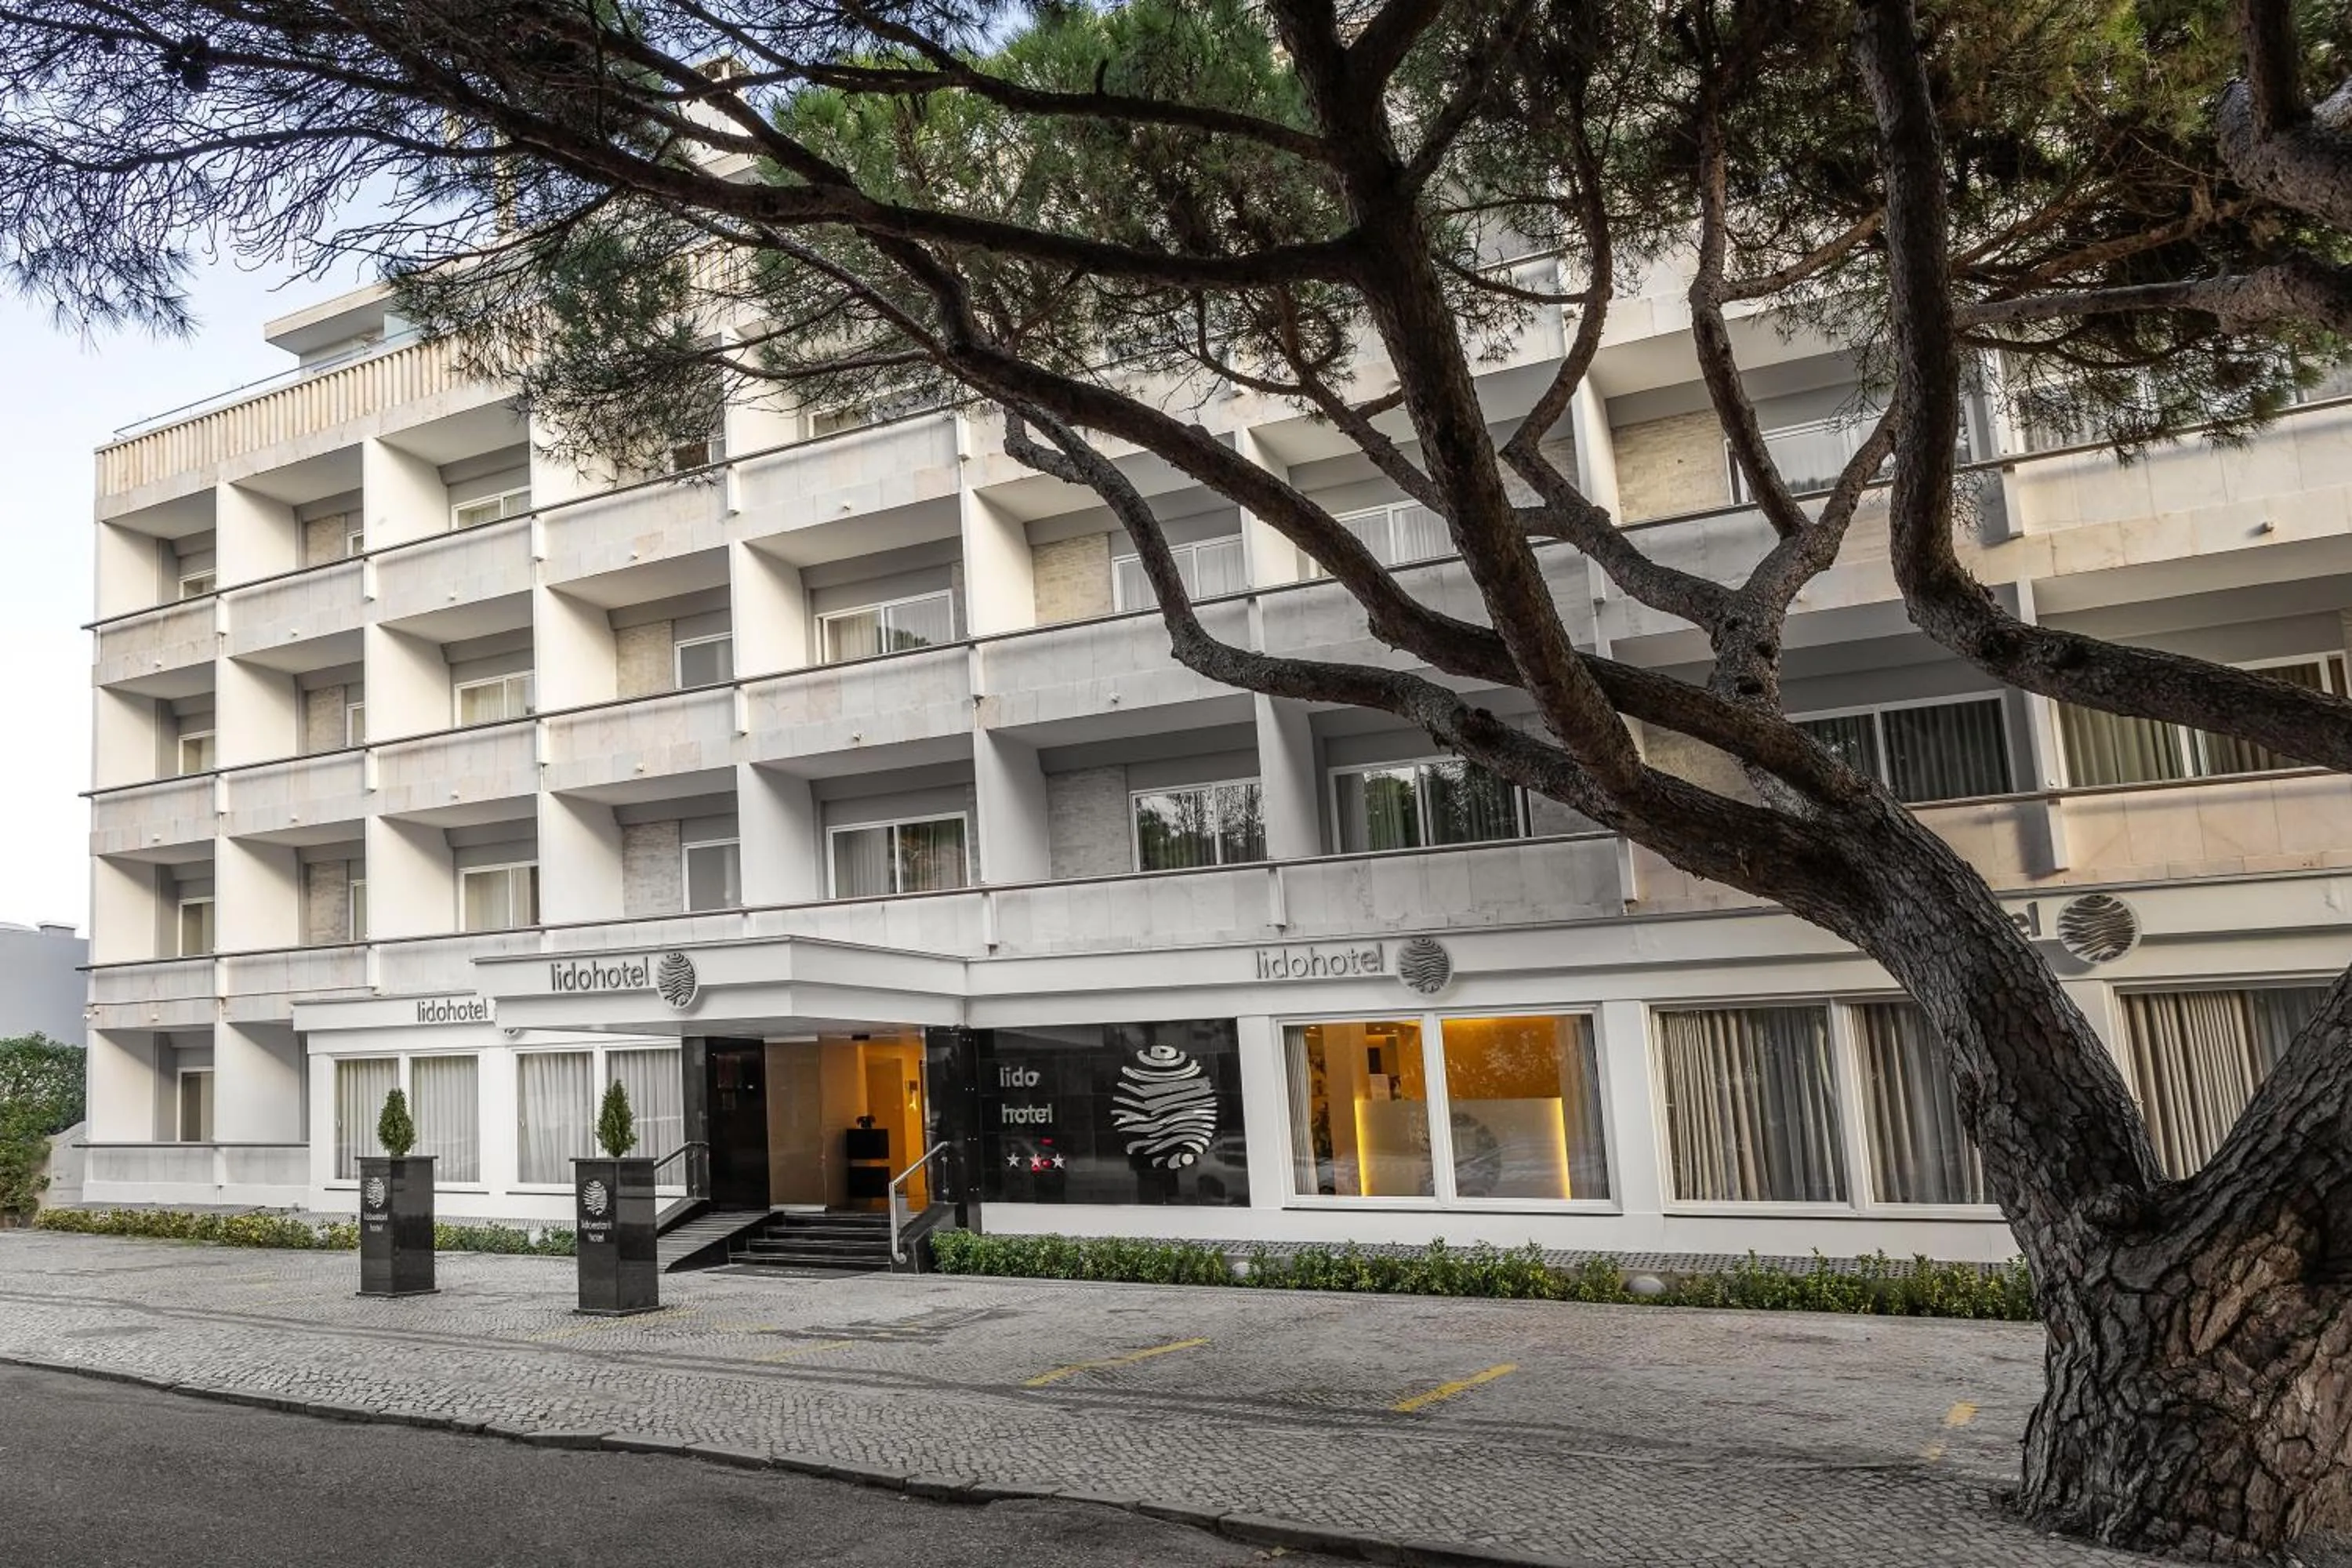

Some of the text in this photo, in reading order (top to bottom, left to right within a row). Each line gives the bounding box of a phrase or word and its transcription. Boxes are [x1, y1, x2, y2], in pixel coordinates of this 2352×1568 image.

[550, 956, 650, 991] lidohotel
[1256, 942, 1384, 979] lidohotel
[416, 997, 488, 1023] lidohotel
[1000, 1066, 1040, 1087] lido
[1001, 1103, 1053, 1123] hotel
